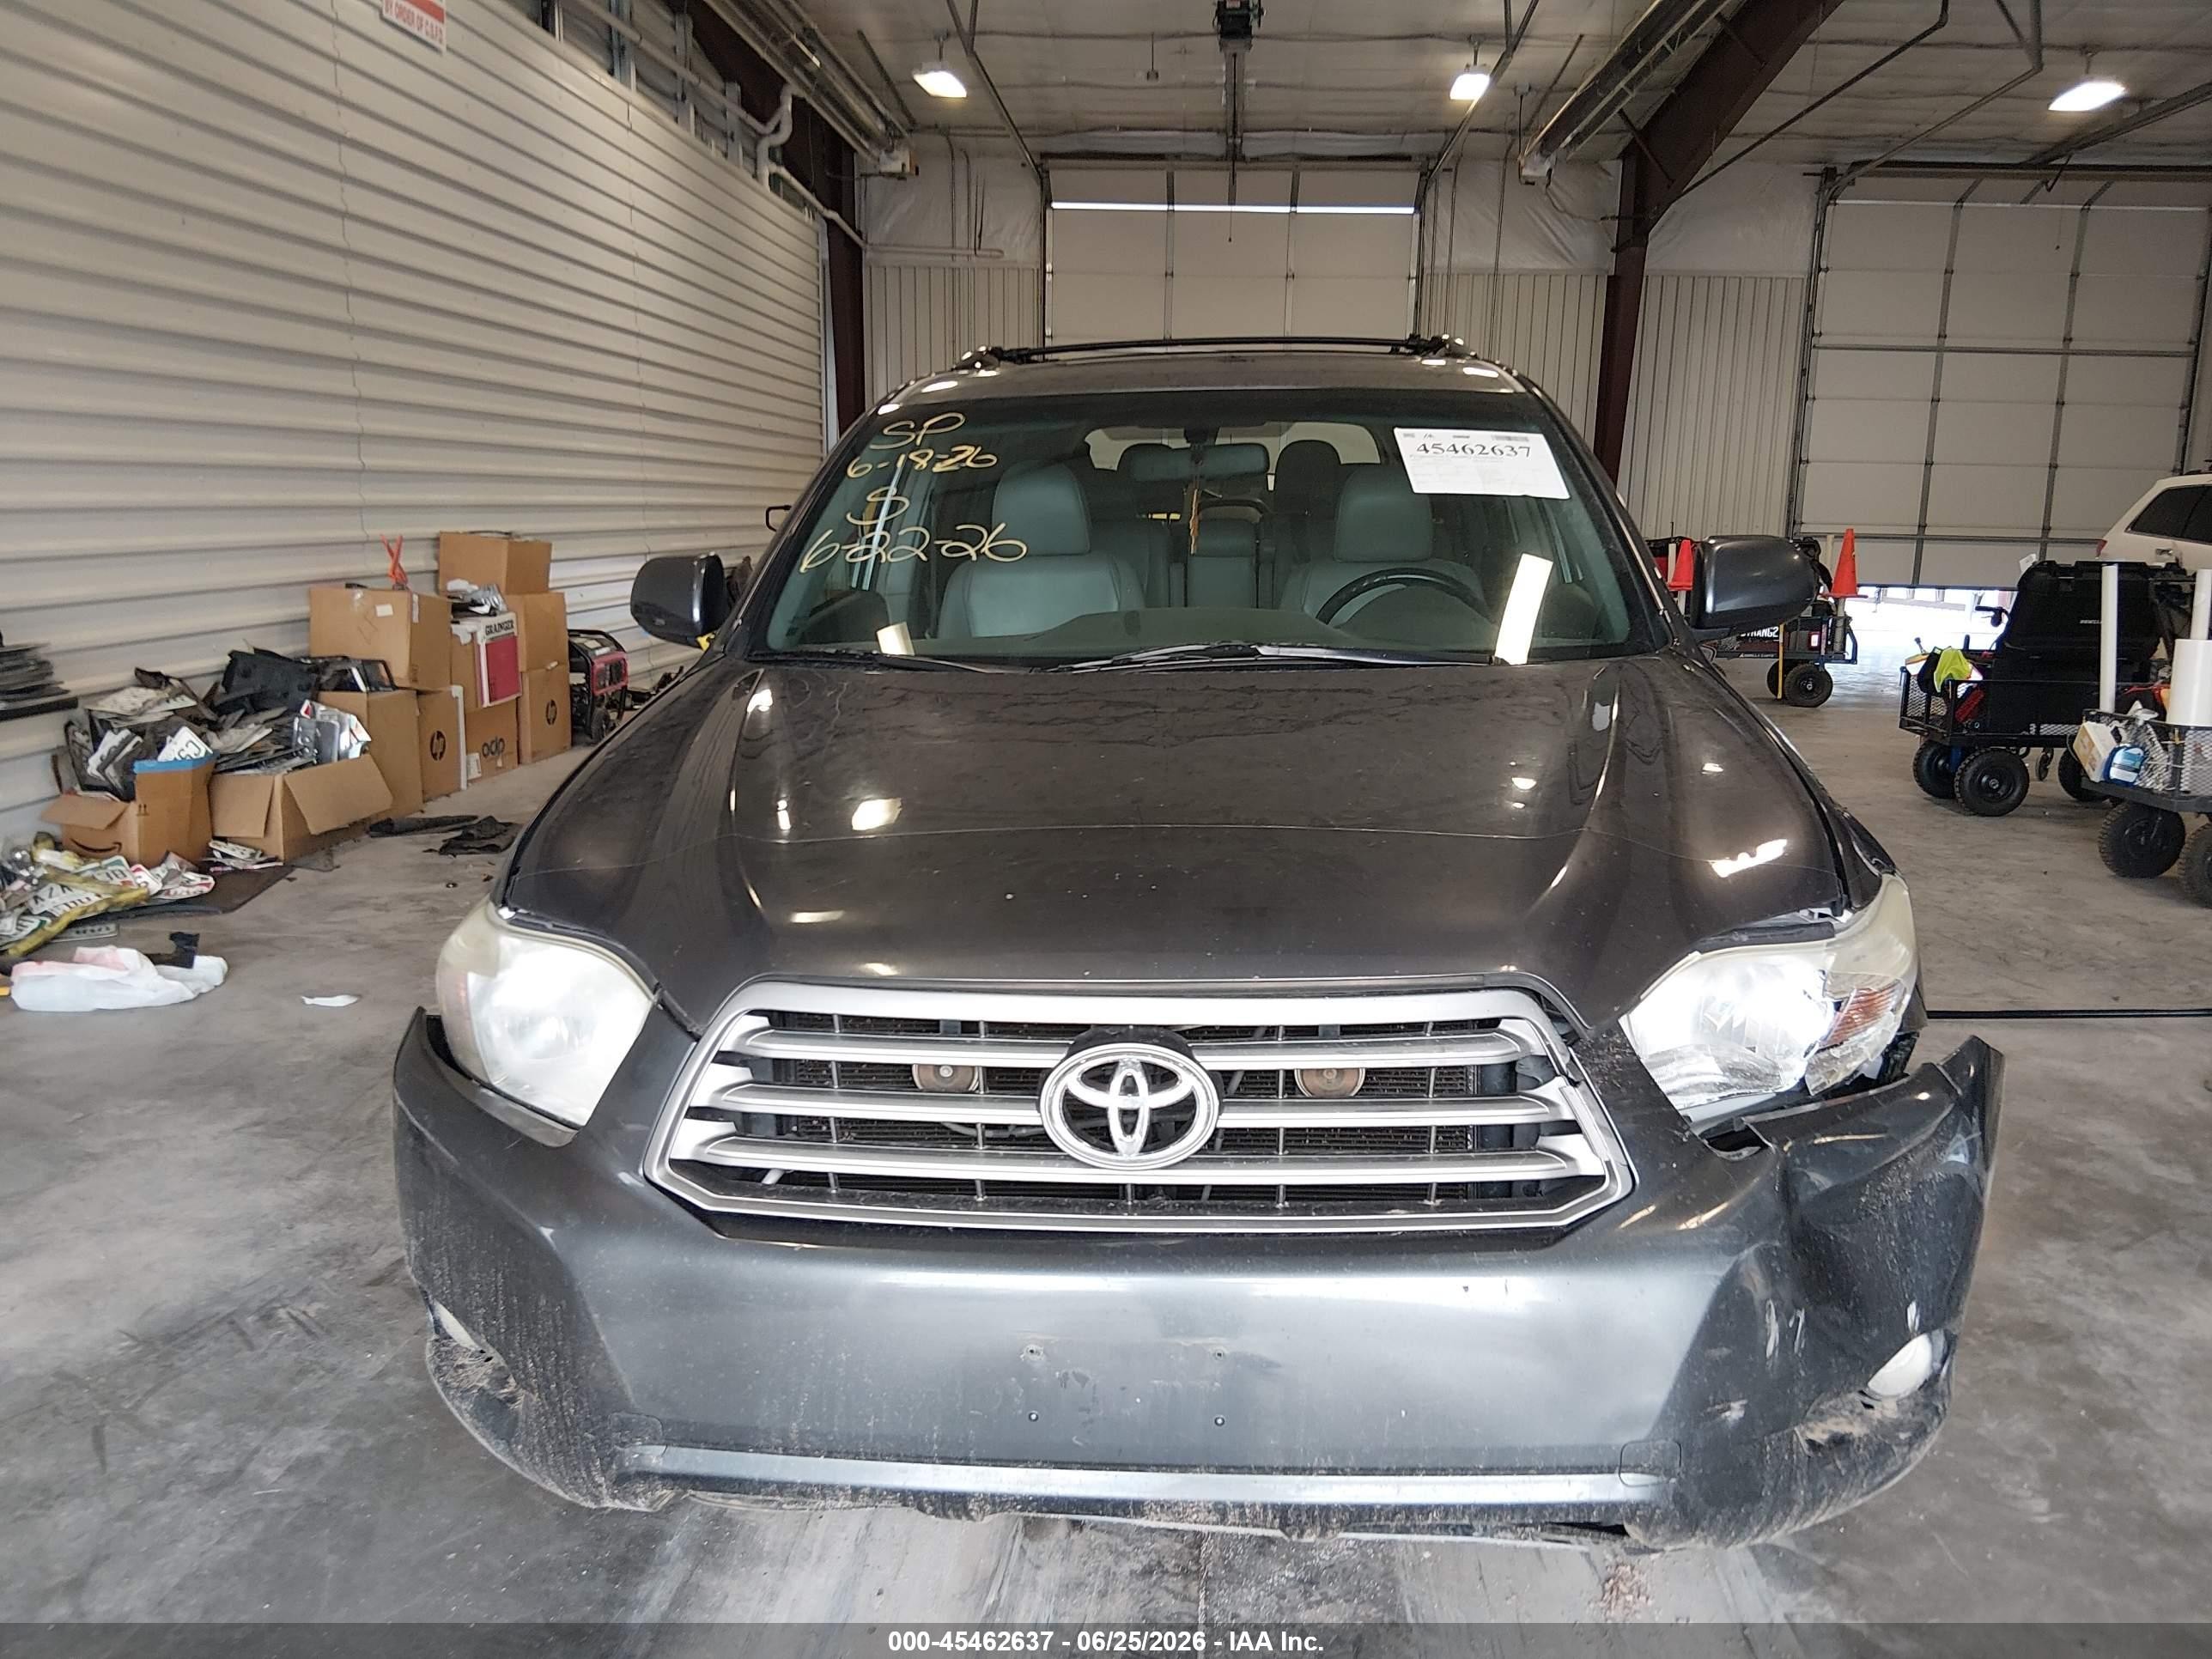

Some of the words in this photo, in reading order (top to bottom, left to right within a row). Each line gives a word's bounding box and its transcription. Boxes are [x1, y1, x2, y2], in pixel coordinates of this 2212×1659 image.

[870, 411, 966, 449] SP
[847, 445, 997, 478] 6-18-26
[1416, 442, 1531, 458] 45462637
[799, 522, 1028, 574] 6-22-26
[485, 619, 514, 635] GRAINGER
